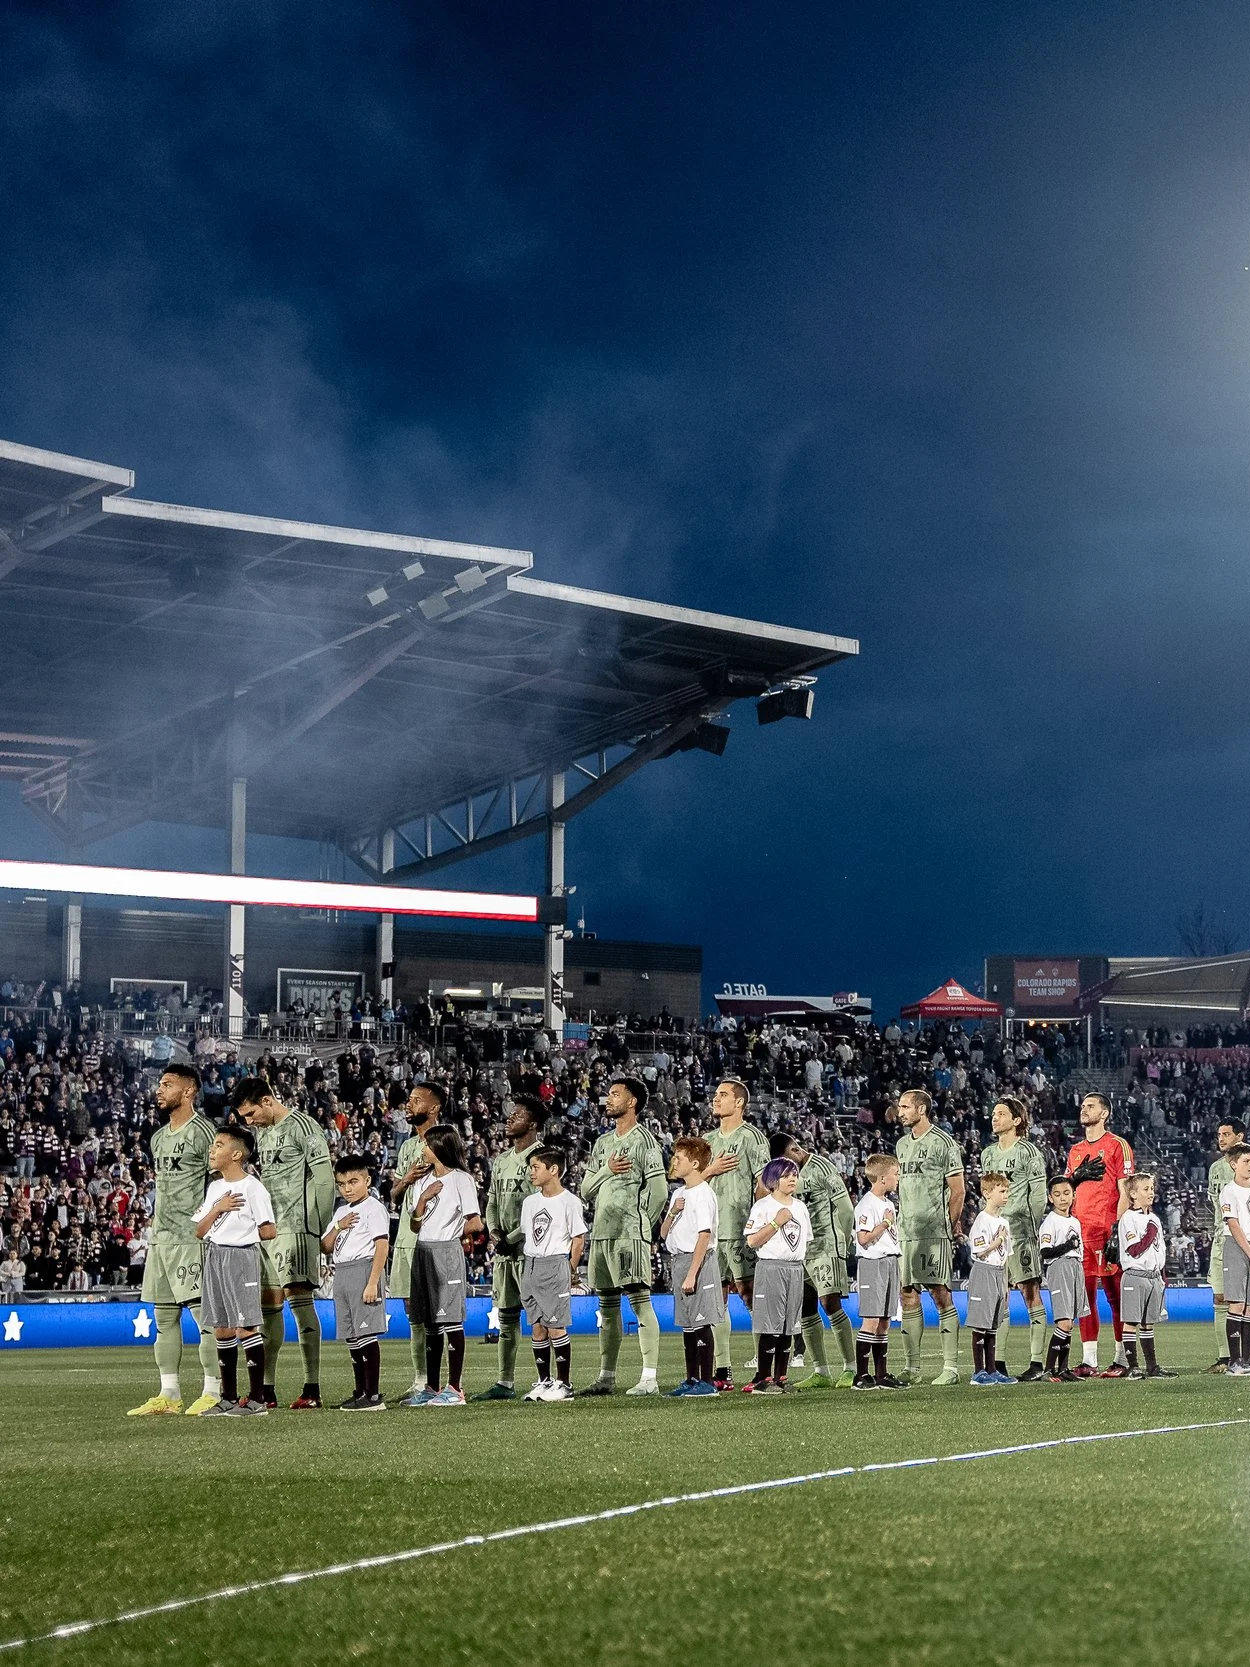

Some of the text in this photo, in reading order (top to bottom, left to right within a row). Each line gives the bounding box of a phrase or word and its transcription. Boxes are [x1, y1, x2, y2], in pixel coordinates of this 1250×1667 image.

[286, 978, 305, 986] EVERY
[305, 979, 328, 987] SEASON
[1017, 978, 1077, 988] COLORADO RAPIDS
[289, 987, 352, 1012] DICKS
[1028, 987, 1066, 997] TEAM SHOP
[157, 1156, 183, 1172] LEX
[261, 1149, 284, 1164] LEX
[920, 1253, 939, 1271] 14
[1019, 1250, 1032, 1267] 6
[176, 1262, 201, 1286] 99
